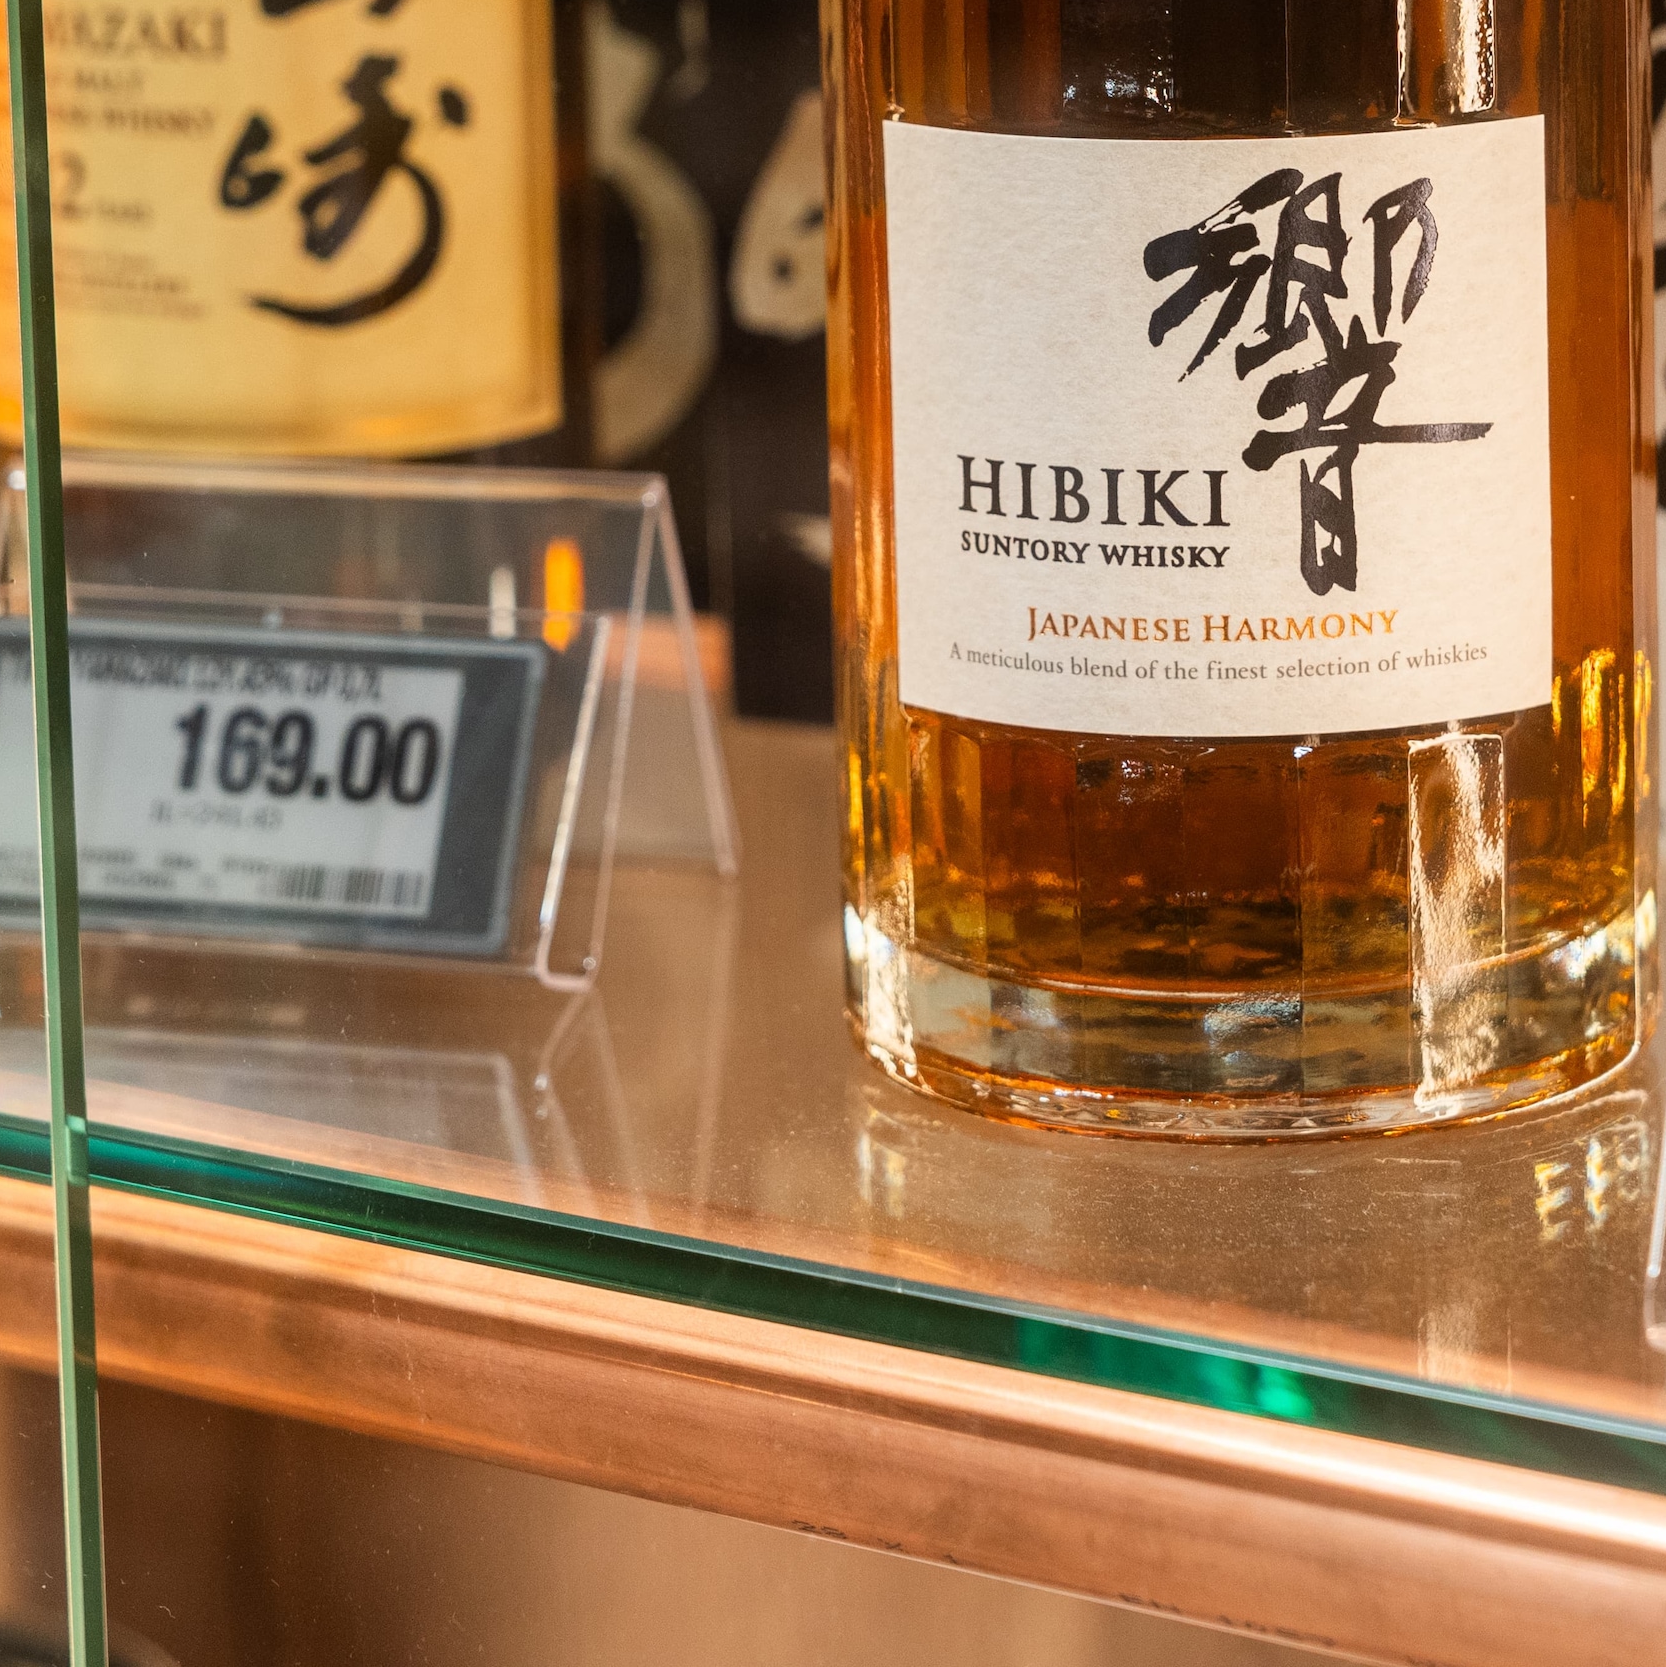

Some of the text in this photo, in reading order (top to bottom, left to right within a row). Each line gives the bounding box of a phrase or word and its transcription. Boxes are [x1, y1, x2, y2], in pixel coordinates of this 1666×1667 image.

[956, 454, 1232, 528] HIBIKI
[960, 529, 1231, 570] SUNTORY WHISKY
[949, 641, 1488, 682] A meticulous blend of the finest selection of whiskies
[176, 702, 443, 806] 169.00
